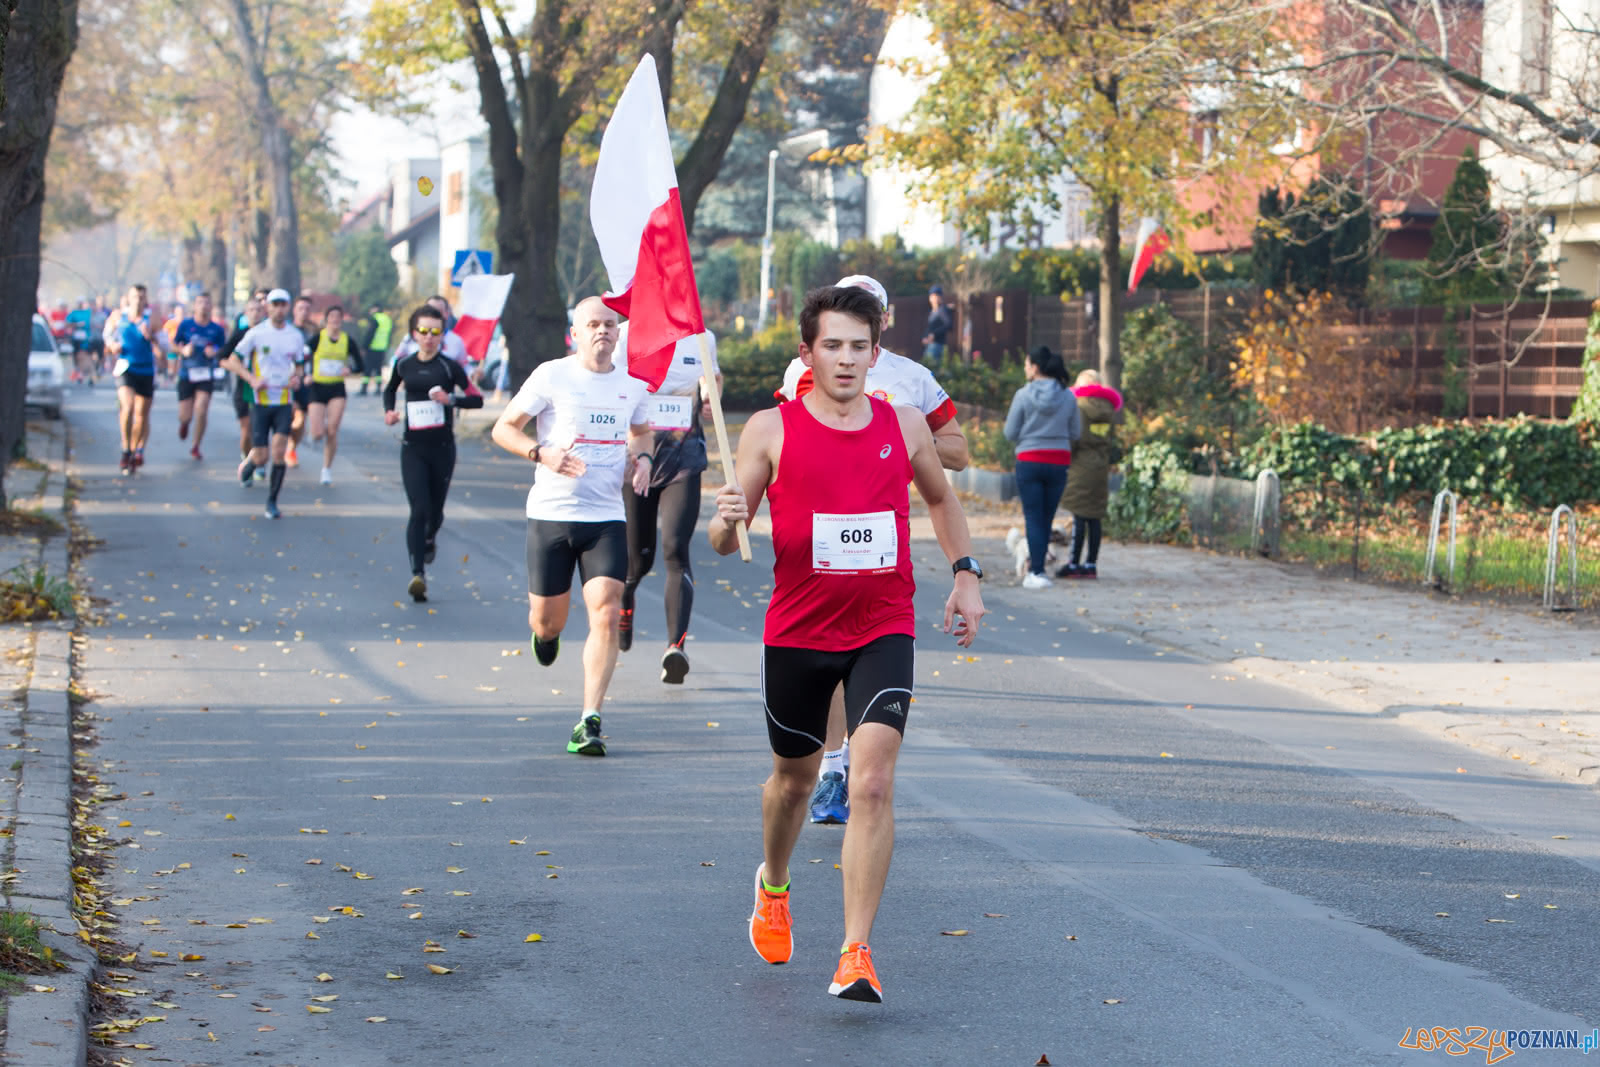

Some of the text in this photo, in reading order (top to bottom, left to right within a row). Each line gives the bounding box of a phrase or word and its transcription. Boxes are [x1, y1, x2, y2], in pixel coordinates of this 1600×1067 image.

[659, 403, 680, 413] 1393
[590, 414, 616, 424] 1026
[840, 529, 873, 543] 608
